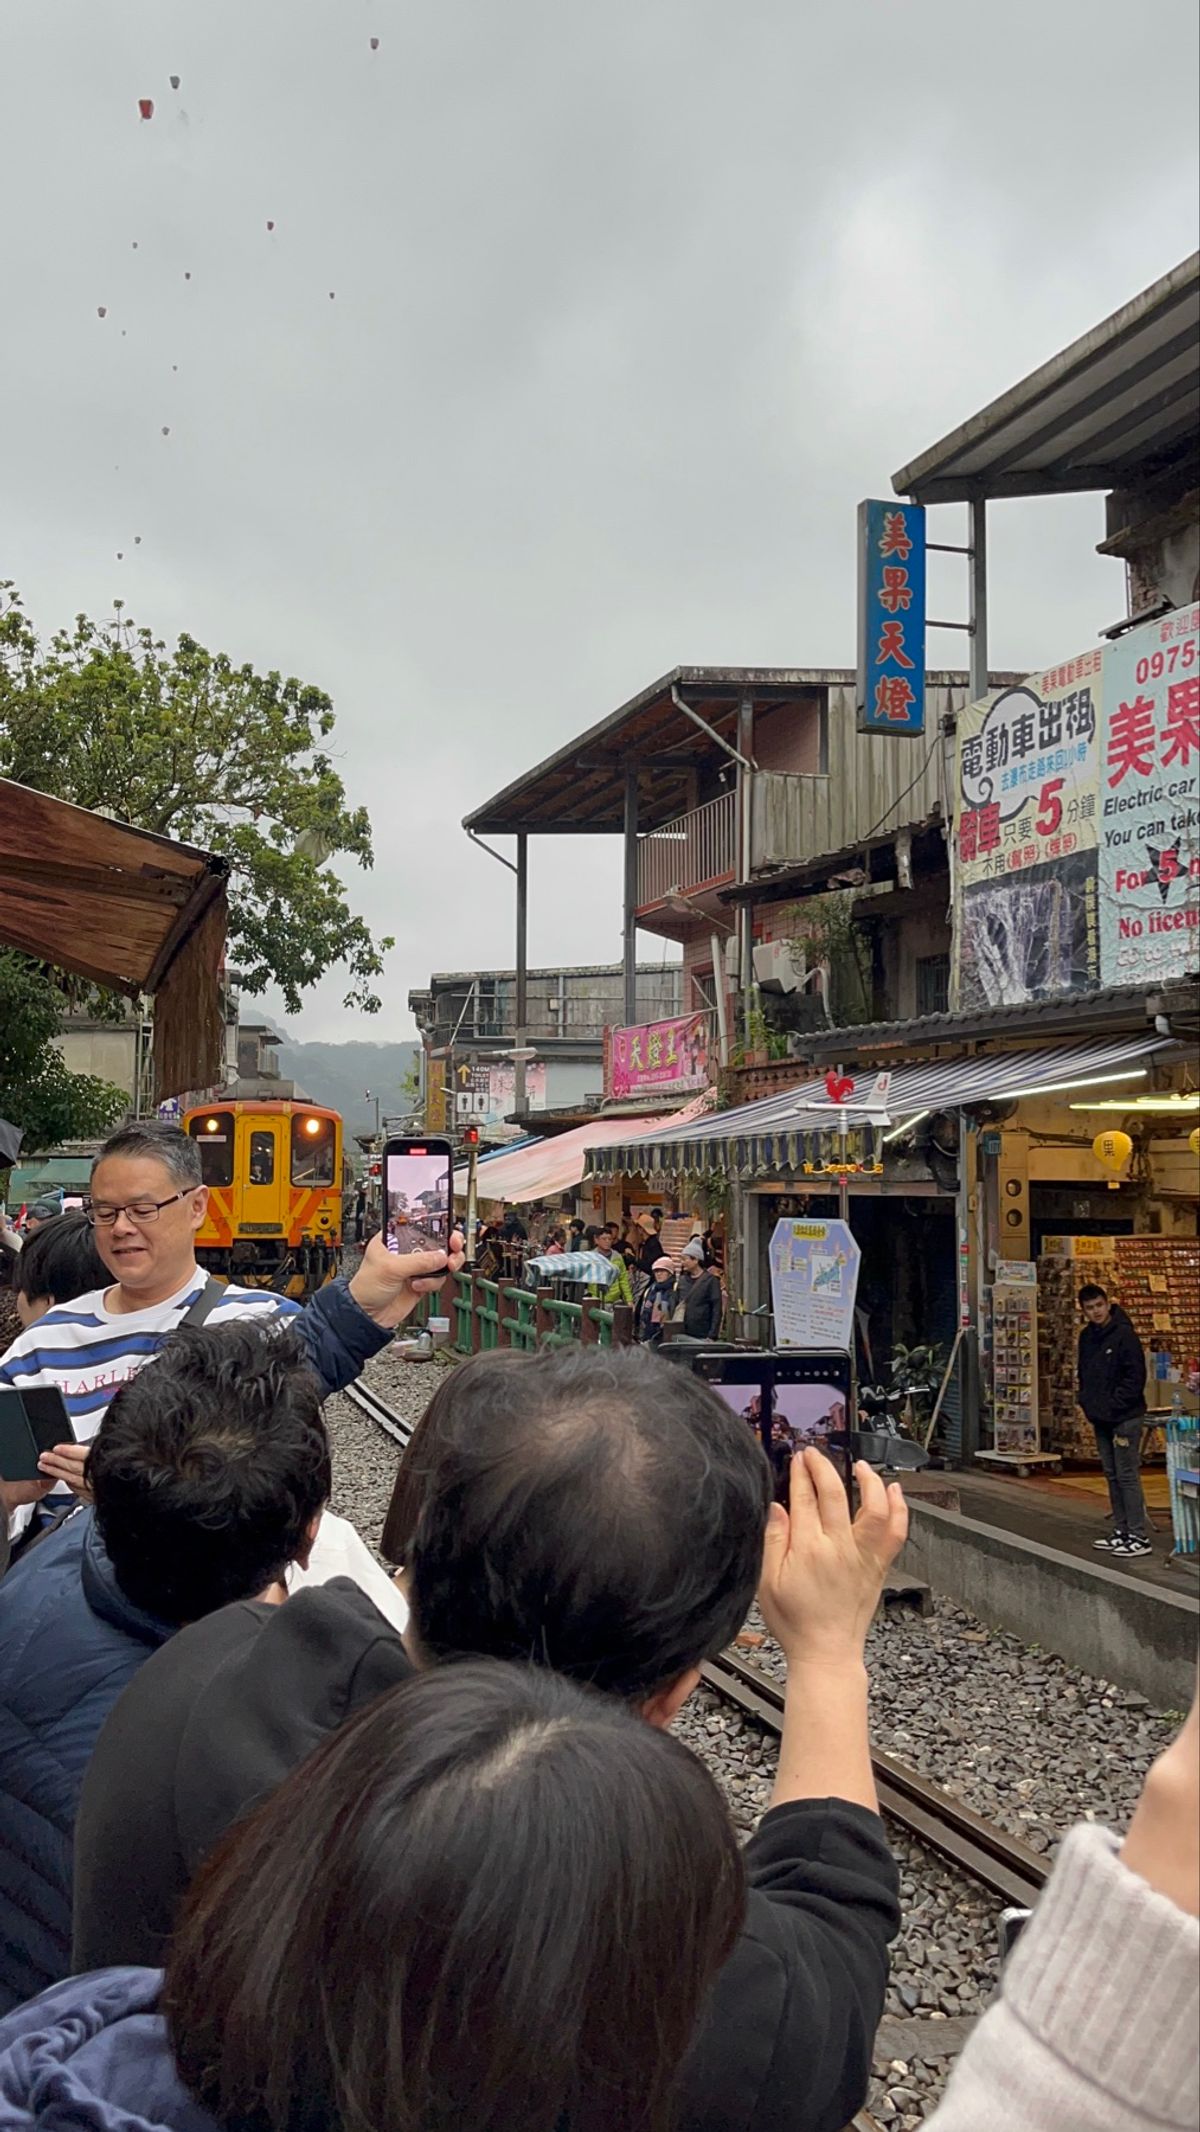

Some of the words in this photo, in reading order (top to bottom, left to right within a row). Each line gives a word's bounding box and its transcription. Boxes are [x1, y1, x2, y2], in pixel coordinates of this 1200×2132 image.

[875, 511, 917, 721] 美果天燈
[960, 687, 1092, 780] 電動車出租
[1103, 784, 1164, 817] Electric
[1167, 777, 1197, 798] car
[1104, 829, 1132, 848] You
[1136, 820, 1166, 840] can
[1115, 868, 1150, 893] For
[1157, 848, 1178, 884] 5
[1118, 916, 1143, 939] No
